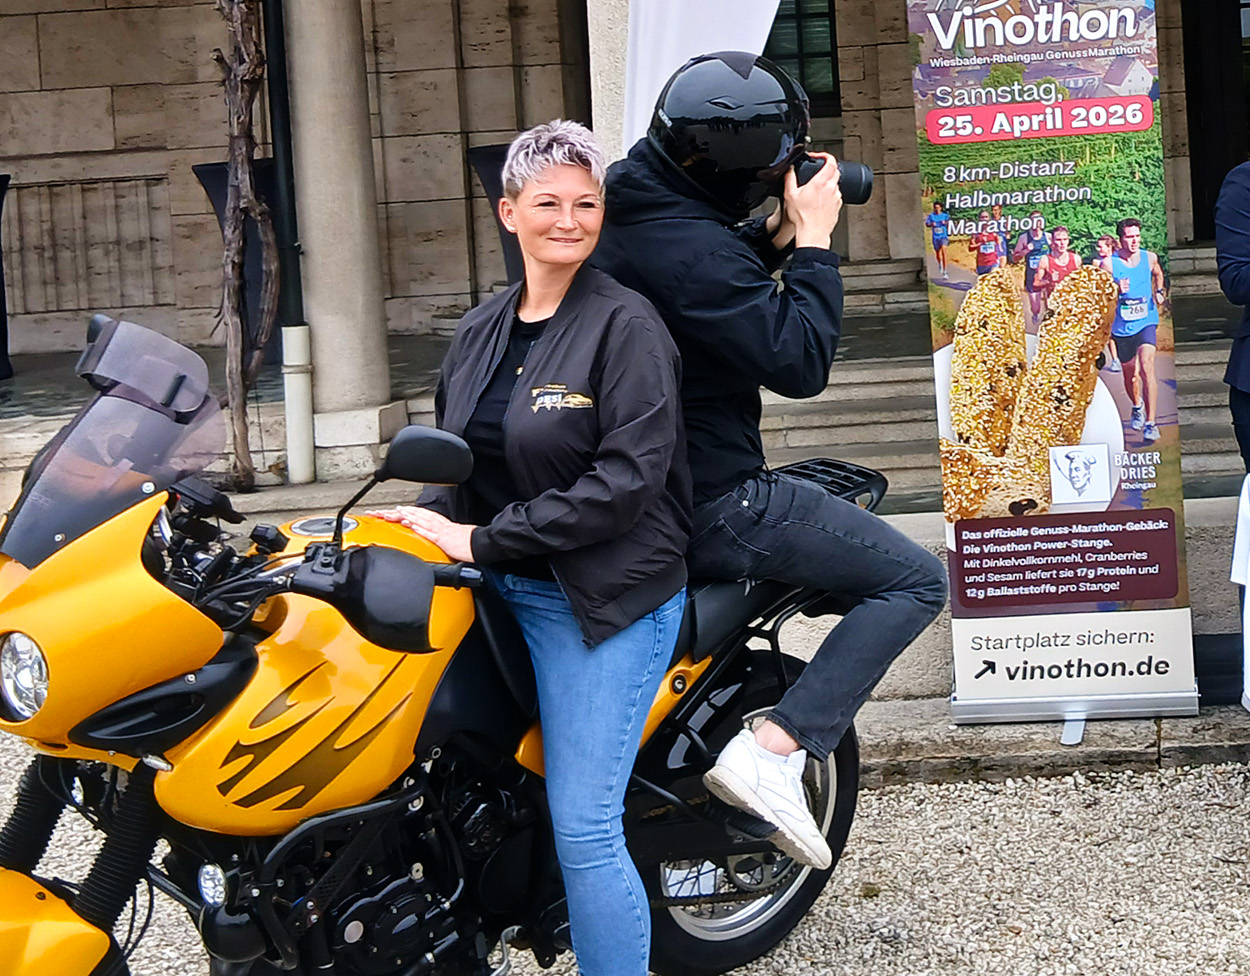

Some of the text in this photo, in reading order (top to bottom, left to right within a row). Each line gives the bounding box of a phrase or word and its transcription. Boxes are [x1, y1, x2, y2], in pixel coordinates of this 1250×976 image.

[926, 2, 1139, 50] Vinothon
[1045, 45, 1141, 60] GenussMarathon
[935, 82, 1064, 106] Samstag,
[937, 103, 1143, 138] 25. April 2026
[945, 185, 1092, 210] Halbmarathon
[947, 215, 1045, 237] Marathon
[1120, 465, 1157, 480] DRIES
[961, 530, 982, 540] Das
[983, 527, 1029, 539] offizielle
[962, 538, 1113, 554] Die Vinothon Power-Stange.
[963, 558, 981, 568] Mit
[1085, 550, 1148, 562] Cranberries
[964, 573, 986, 583] und
[986, 572, 1023, 582] Sesam
[1025, 569, 1057, 580] liefert
[1058, 568, 1075, 578] sie
[1096, 564, 1137, 576] Protein
[1138, 564, 1159, 574] und
[986, 583, 1057, 596] Ballaststoffe
[1058, 583, 1077, 594] pro
[1078, 581, 1120, 593] Stange!
[970, 628, 1155, 652] Startplatz sichern:
[1004, 655, 1171, 681] vinothon.de
